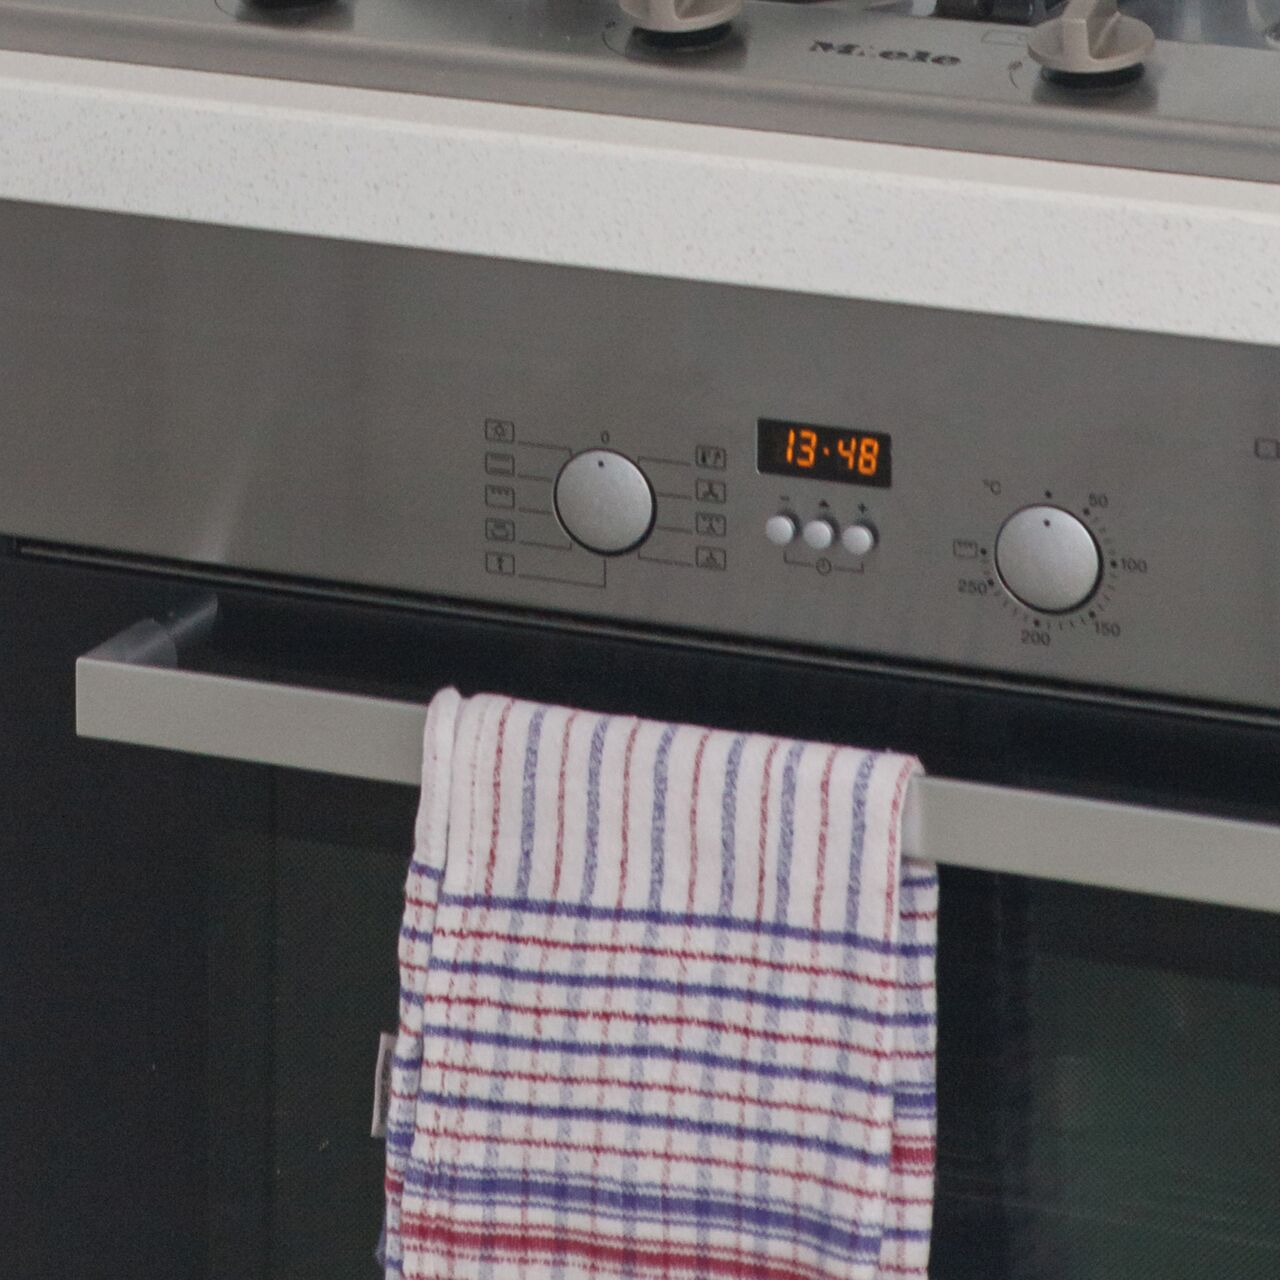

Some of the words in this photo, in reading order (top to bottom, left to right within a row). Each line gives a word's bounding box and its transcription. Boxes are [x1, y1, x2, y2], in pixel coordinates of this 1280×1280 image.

[809, 40, 961, 66] Mele
[1088, 493, 1109, 508] 50
[1120, 557, 1148, 573] 100
[958, 578, 988, 596] 250
[1021, 629, 1051, 646] 200
[1094, 621, 1120, 638] 150
